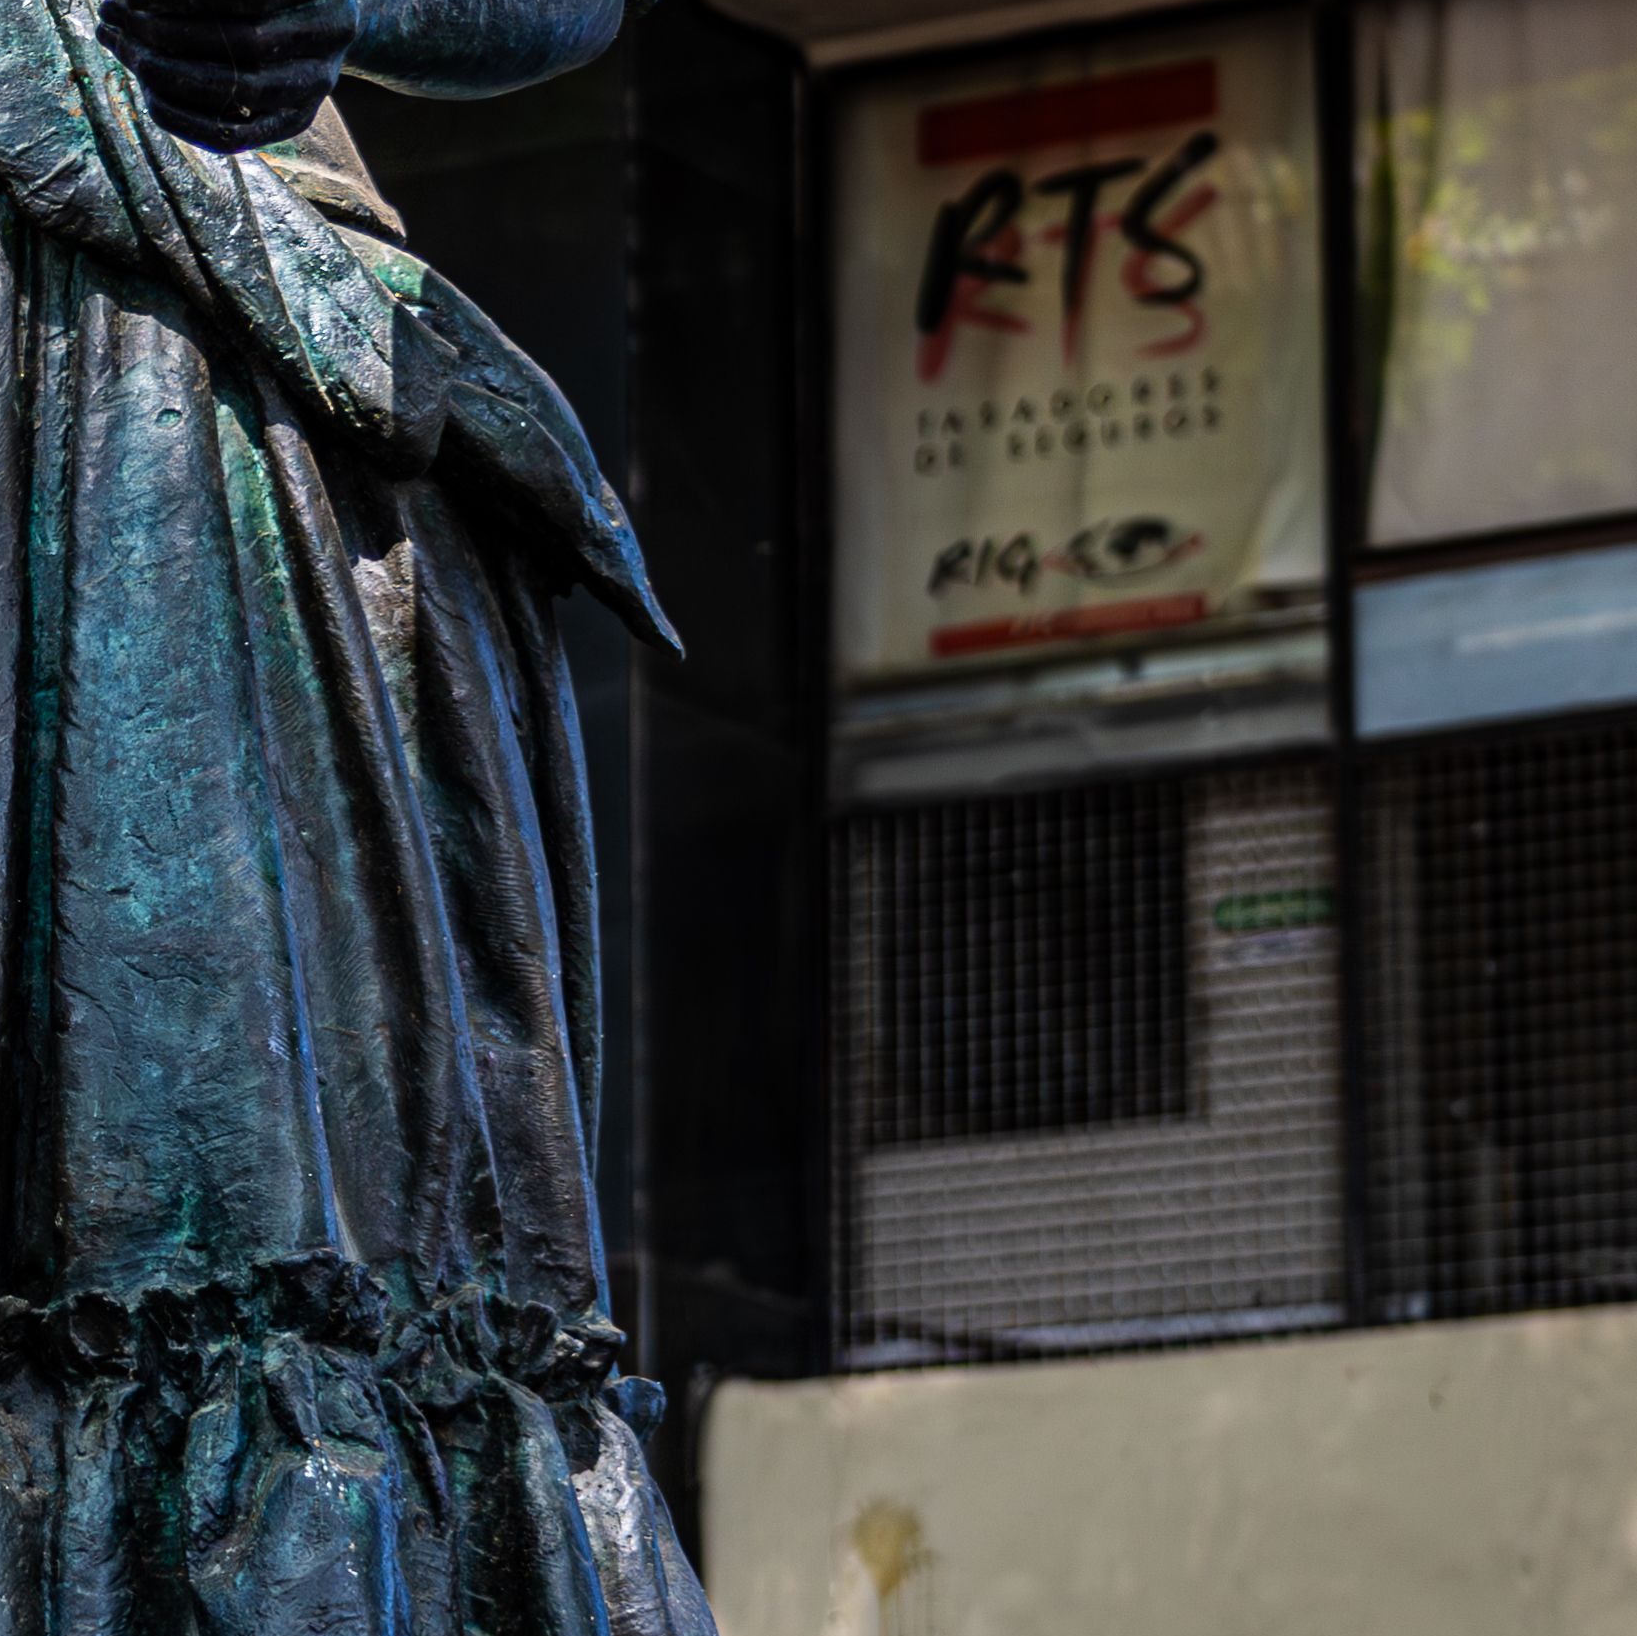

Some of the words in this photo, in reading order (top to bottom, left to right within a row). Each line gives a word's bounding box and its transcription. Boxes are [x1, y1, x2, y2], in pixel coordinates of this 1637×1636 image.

[915, 129, 1220, 368] RTS
[913, 439, 966, 477] DE
[1005, 403, 1223, 464] SEGUROS
